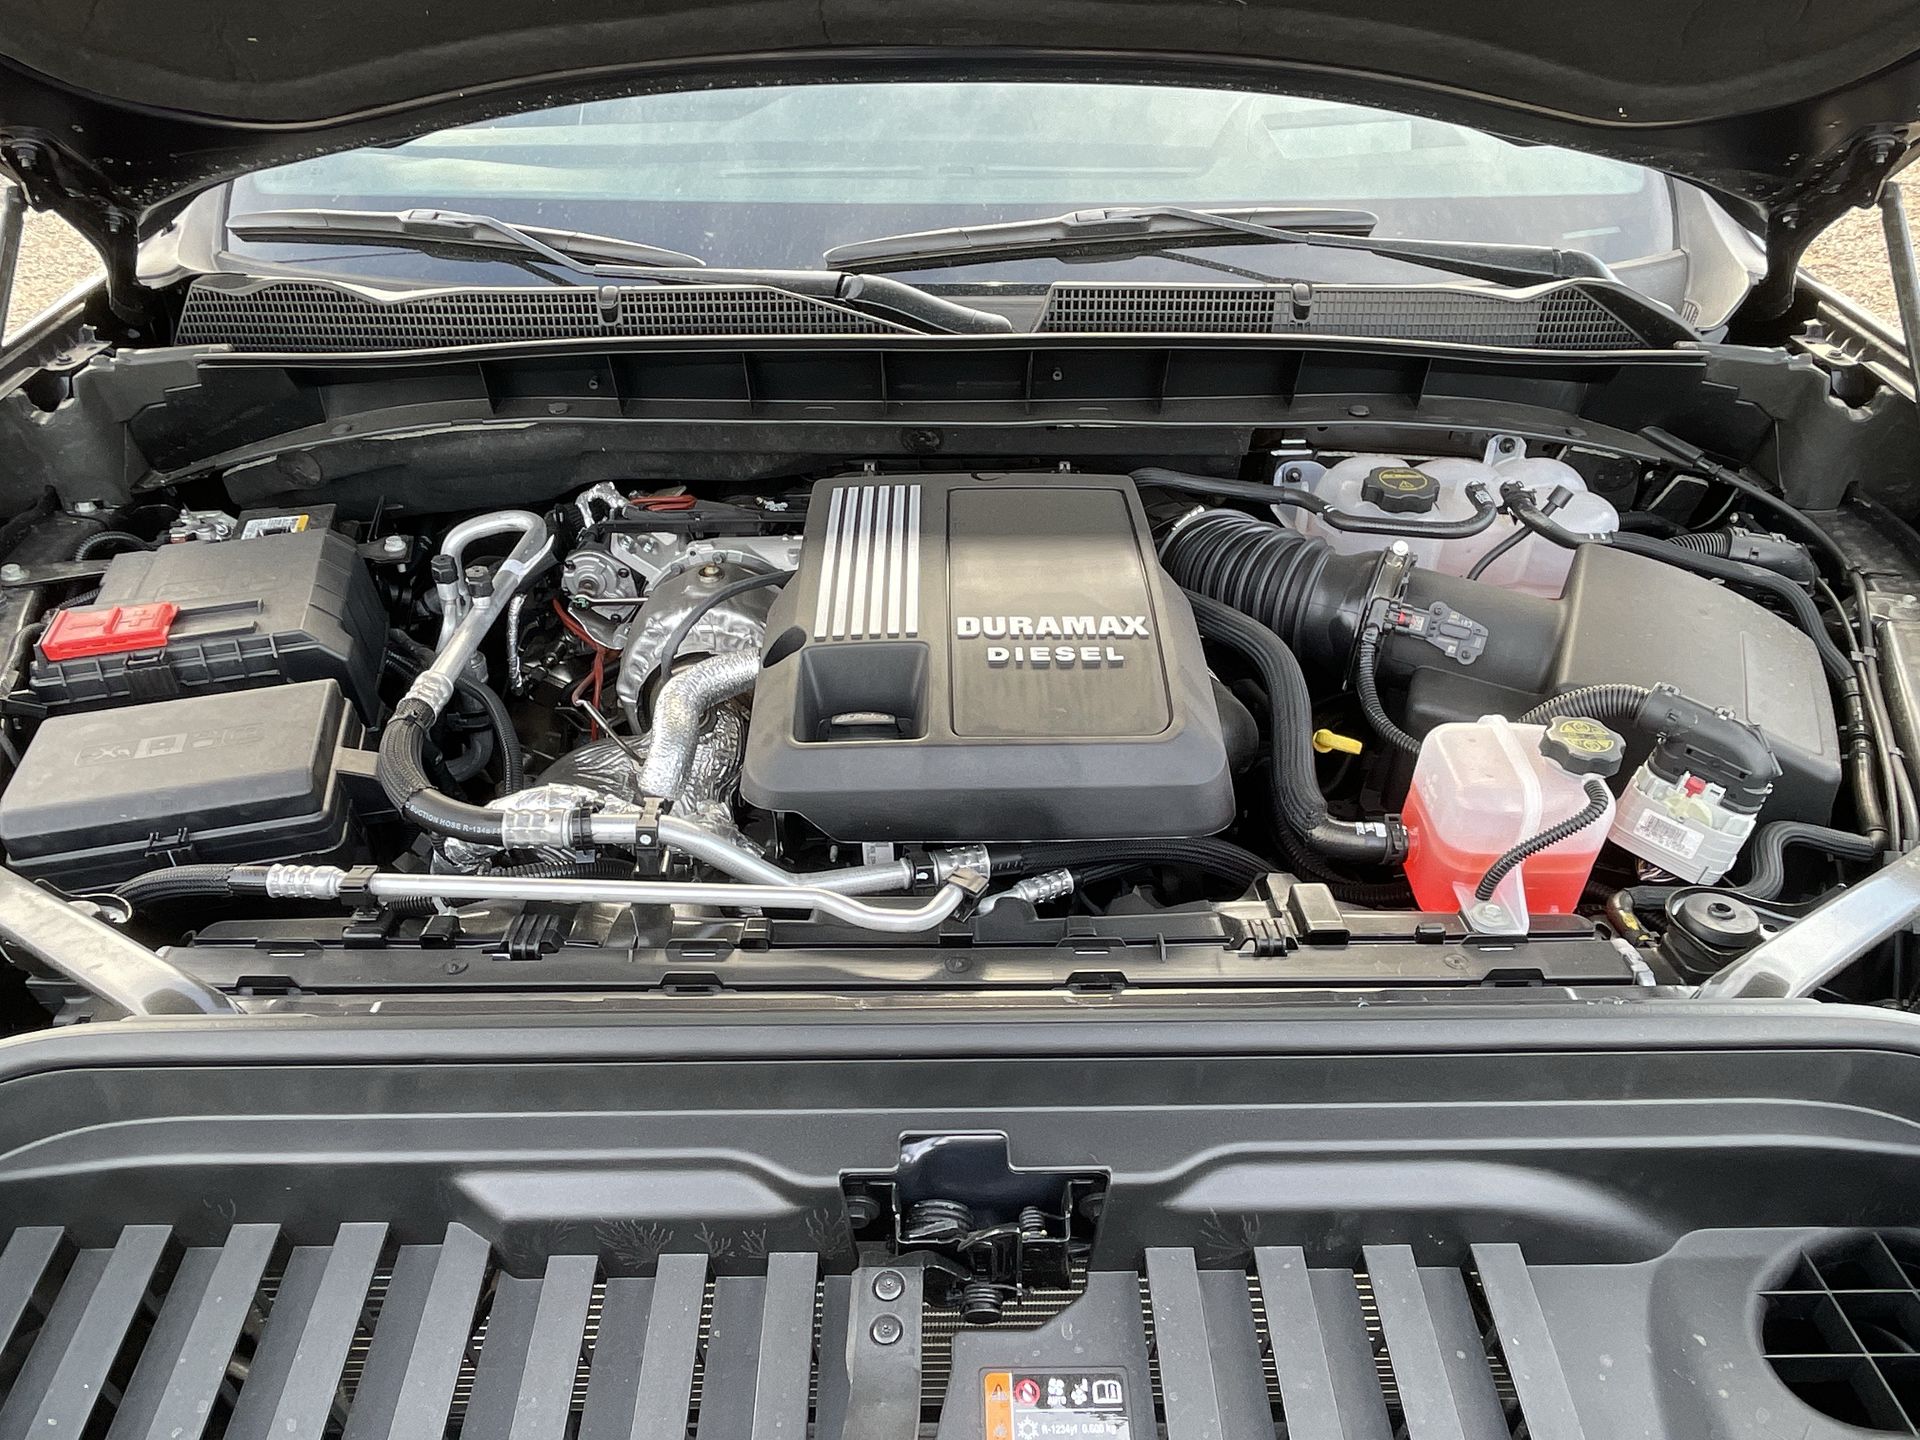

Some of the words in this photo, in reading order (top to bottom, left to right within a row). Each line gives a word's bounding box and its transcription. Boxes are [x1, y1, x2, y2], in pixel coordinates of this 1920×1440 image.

[956, 615, 1150, 639] DURAMAX
[986, 646, 1125, 667] DIESEL
[410, 805, 438, 824] SUCTION
[439, 818, 461, 830] HOSE
